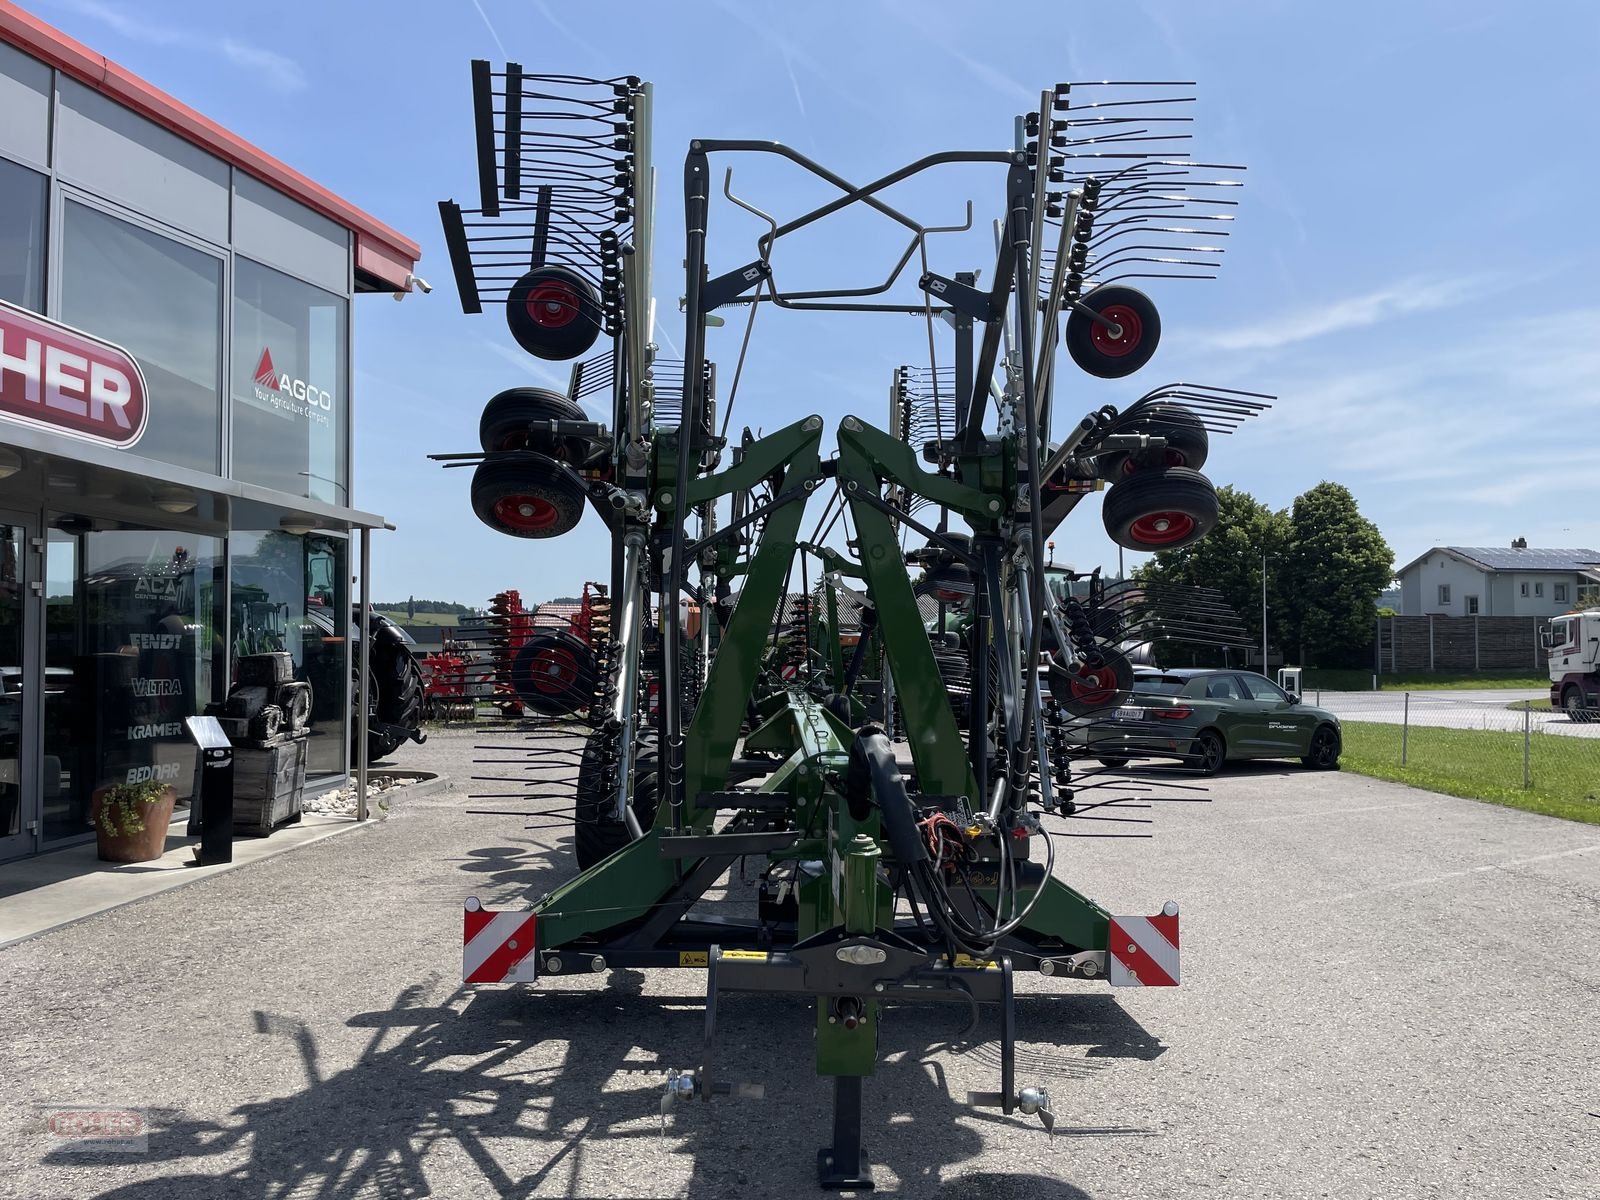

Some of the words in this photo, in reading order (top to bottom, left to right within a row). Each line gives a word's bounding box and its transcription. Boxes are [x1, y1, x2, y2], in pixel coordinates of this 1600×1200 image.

[280, 373, 330, 411] AGCO
[254, 386, 269, 401] Your
[270, 393, 303, 416] Agriculture
[304, 406, 329, 428] Company
[129, 633, 182, 650] FENDT
[131, 677, 182, 697] VALTRA
[128, 722, 182, 740] KRAMER
[126, 763, 180, 784] BEDNAR
